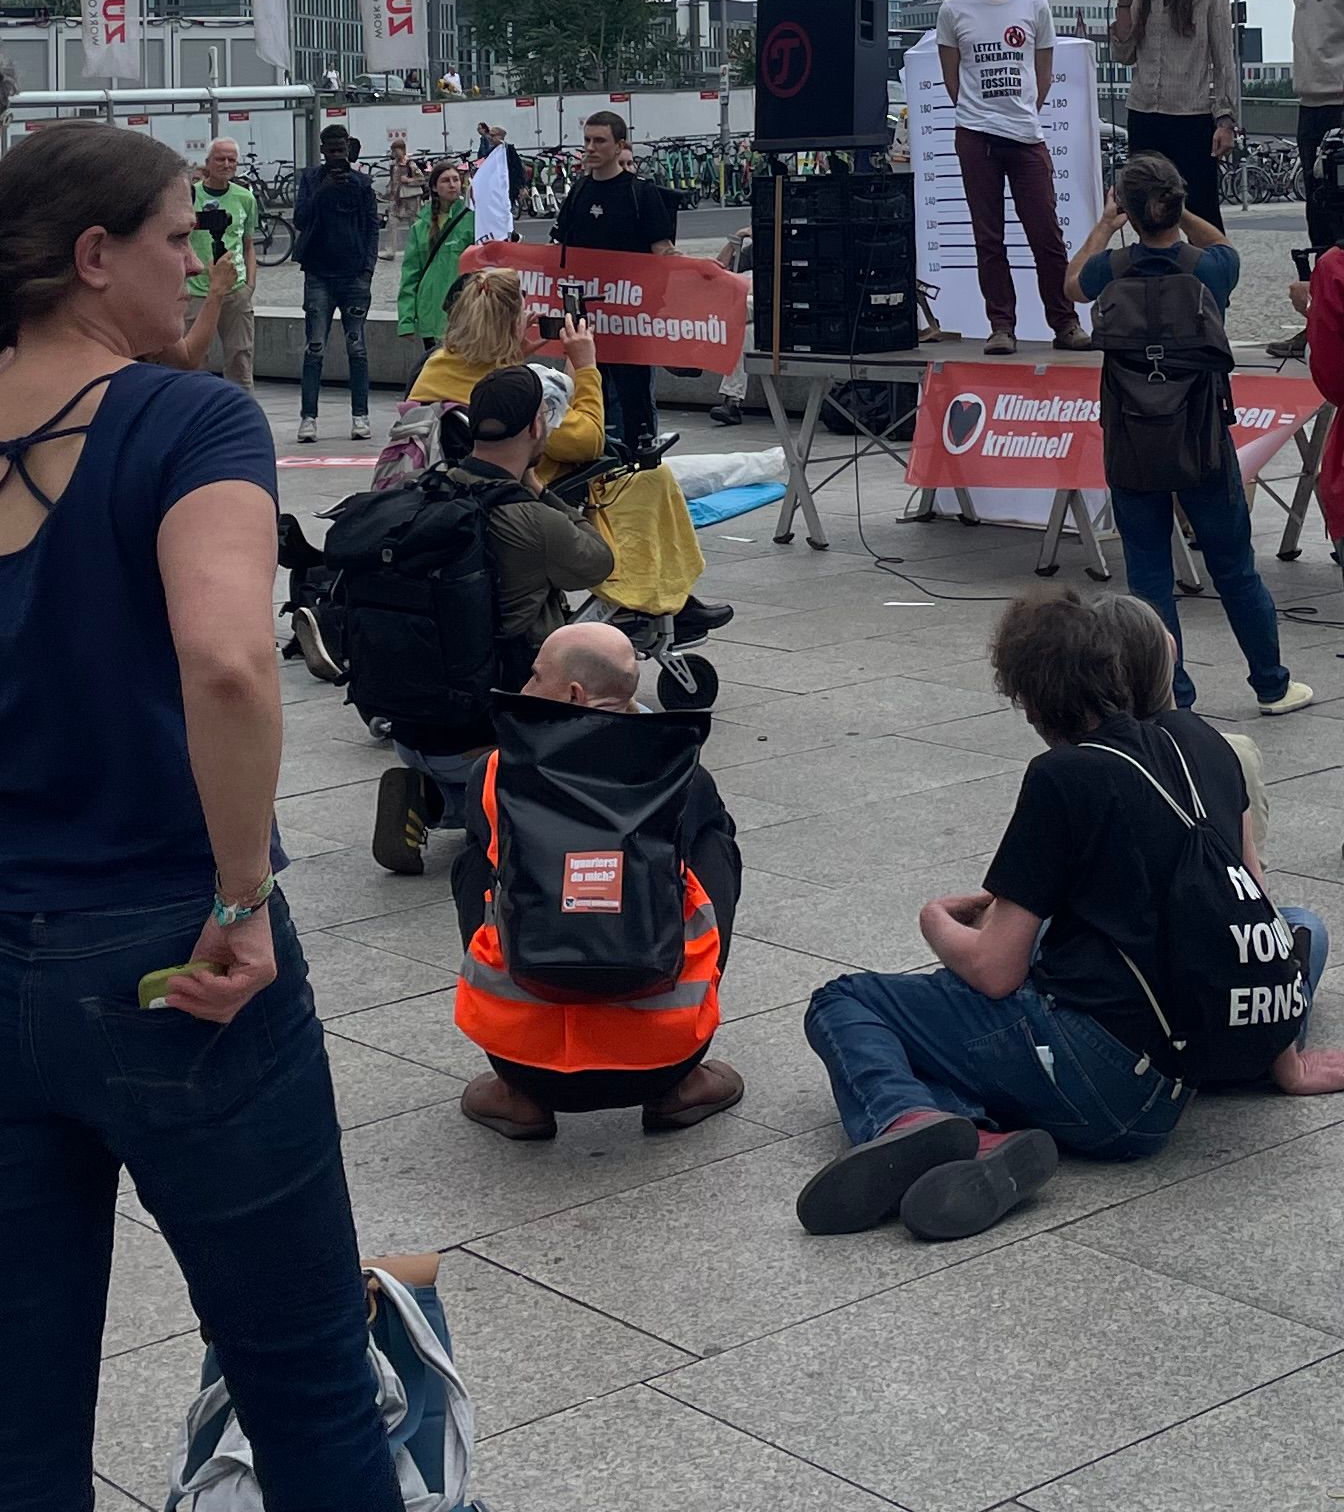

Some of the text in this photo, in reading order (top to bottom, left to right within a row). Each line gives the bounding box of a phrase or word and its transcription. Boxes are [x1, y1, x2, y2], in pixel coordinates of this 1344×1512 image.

[973, 42, 1002, 53] LETZTE
[981, 77, 1022, 90] FOSSILEN
[1052, 121, 1069, 131] 170
[1052, 146, 1068, 156] 160
[1058, 216, 1070, 226] 30
[518, 270, 553, 297] Wir
[603, 280, 643, 306] alle
[992, 394, 1101, 422] Klimakatas
[1233, 407, 1276, 429] sen
[980, 431, 1073, 458] kriminell
[1228, 976, 1304, 1026] ERNS
